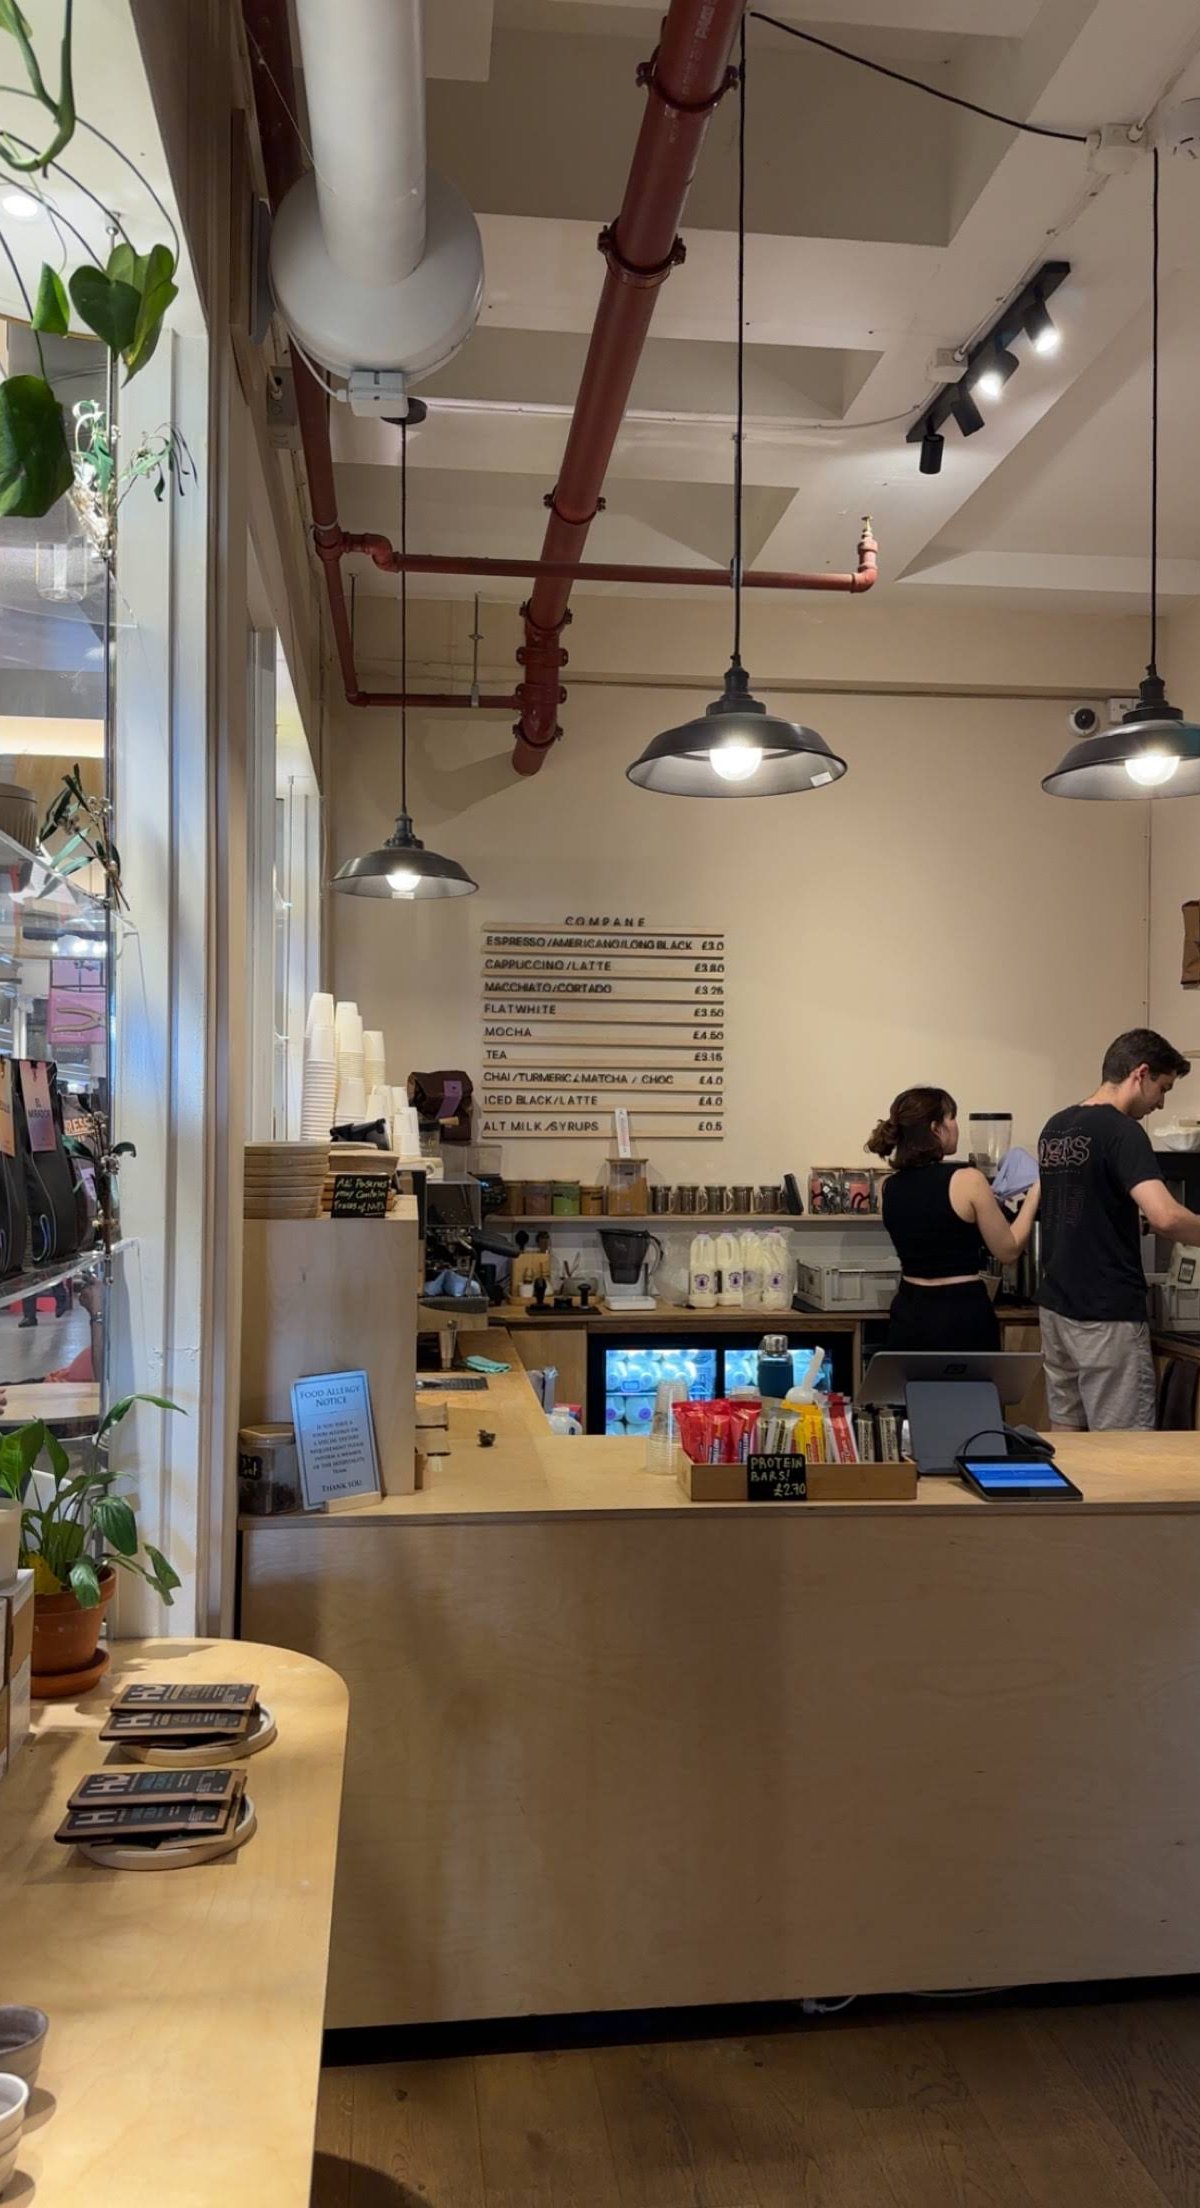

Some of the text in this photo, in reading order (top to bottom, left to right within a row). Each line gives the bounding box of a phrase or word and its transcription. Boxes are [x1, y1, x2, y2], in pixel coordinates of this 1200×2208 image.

[485, 1027, 532, 1037] MOCHA
[486, 1049, 507, 1060] TEA
[641, 1075, 674, 1084] CHOC
[484, 1095, 512, 1105] ICED
[483, 1121, 506, 1131] ALT
[750, 1456, 803, 1470] PROTEIN
[750, 1469, 791, 1482] BARS!
[773, 1482, 806, 1497] £2.70
